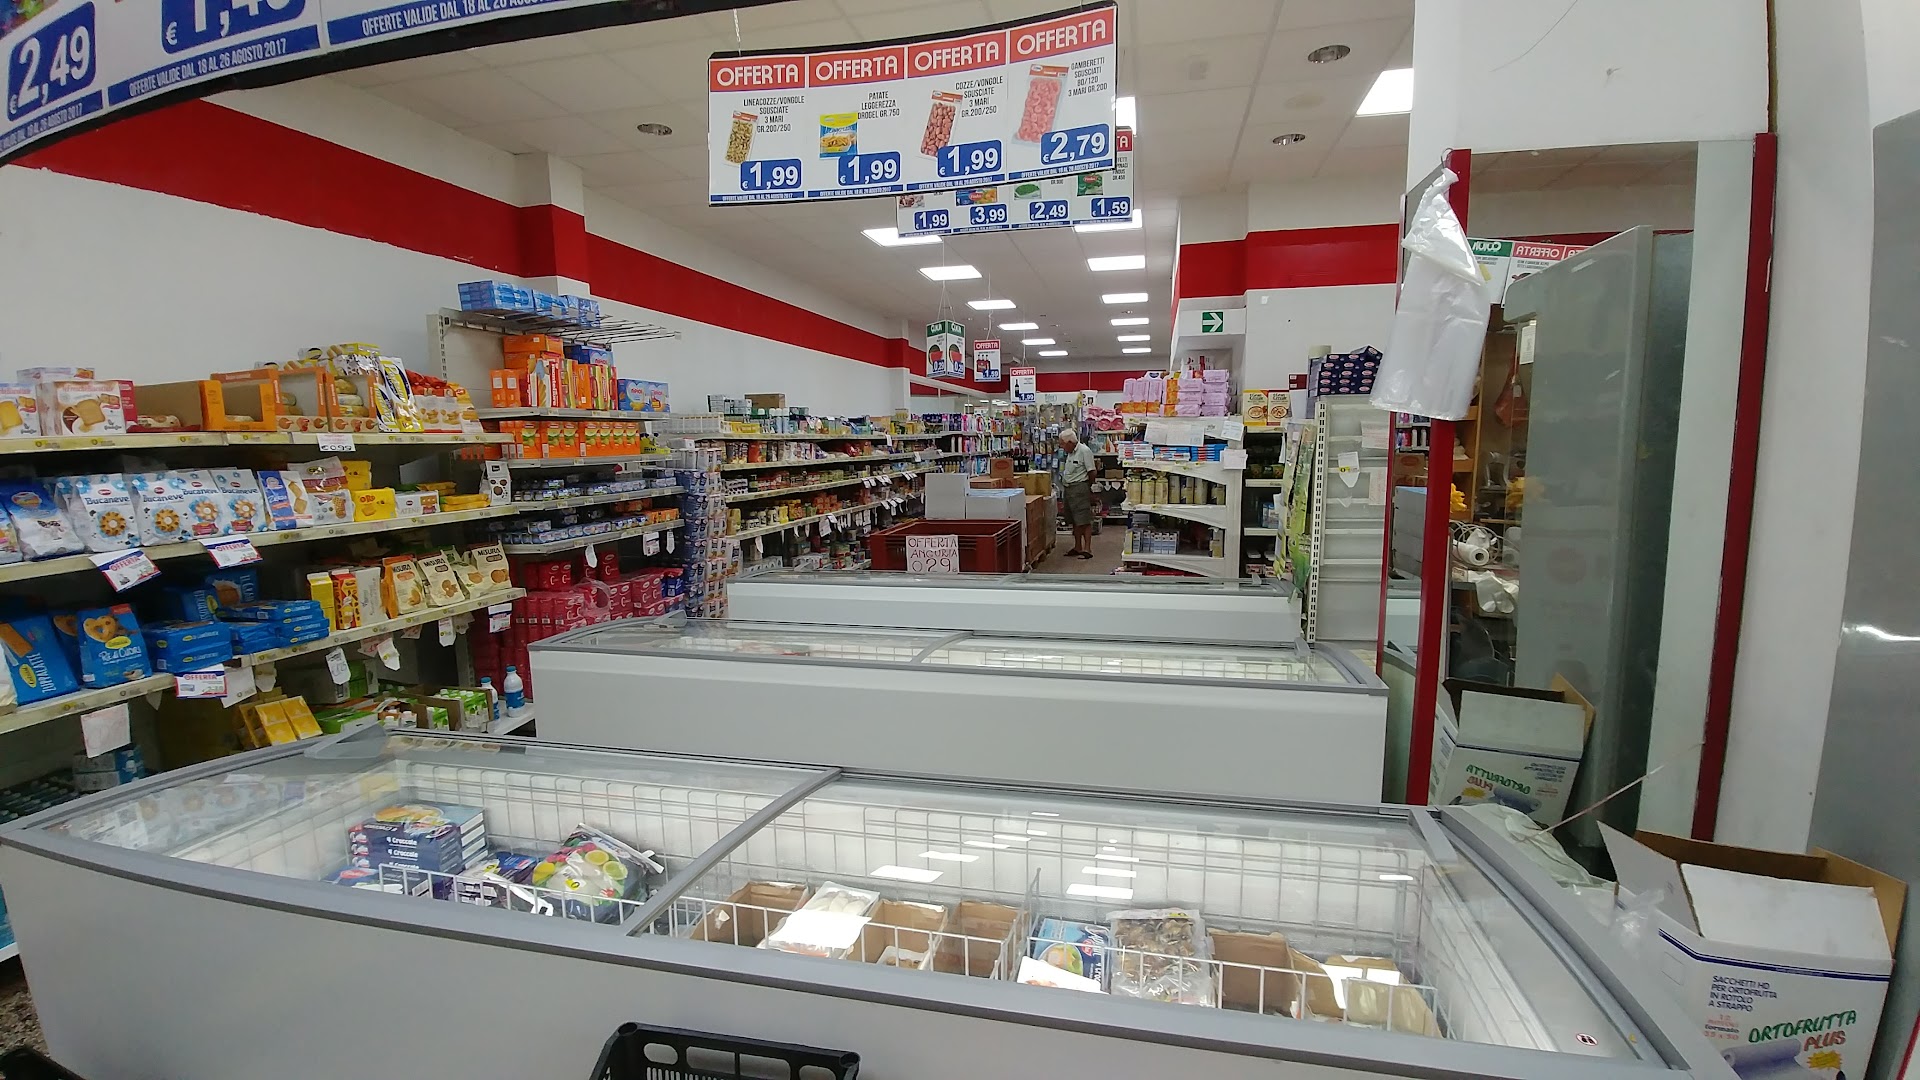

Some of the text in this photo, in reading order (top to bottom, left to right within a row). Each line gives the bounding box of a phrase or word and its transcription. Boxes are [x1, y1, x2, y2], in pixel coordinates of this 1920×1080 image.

[362, 16, 404, 36] OFFERTE
[403, 6, 439, 27] VALIDE
[440, 1, 460, 20] DAL
[462, 0, 475, 15] 18
[1016, 18, 1106, 55] OFFERTA
[914, 41, 999, 71] OFFERTA
[18, 26, 90, 108] 2,49
[129, 37, 287, 97] OFFERTE VALIDE DAL 18 AL 26 AGOSTO 2017
[815, 55, 898, 81] OFFERTA
[1070, 57, 1105, 70] GAMBERETTI
[716, 63, 799, 87] OFFERTA
[1074, 66, 1102, 78] SGUSCIATI
[955, 75, 1004, 90] COZZE/VONGOLE
[868, 91, 889, 100] PATATE
[963, 87, 995, 99] SGUSCIATE
[1068, 89, 1072, 97] 3
[1072, 86, 1087, 96] MARI
[861, 100, 896, 111] LEGGEREZZA
[969, 97, 990, 107] 3 MARI
[68, 103, 83, 119] 2017
[759, 106, 789, 115] SGUSCIATE
[764, 115, 784, 124] 3 MARI
[1050, 132, 1105, 161] 2,79
[947, 146, 999, 175] 1,99
[750, 162, 799, 190] 1,99
[848, 155, 898, 185] 1,99
[974, 206, 1006, 223] 3,99
[1033, 202, 1067, 219] 2,49
[1097, 200, 1128, 217] 1,59
[919, 212, 948, 228] 1,99
[975, 342, 998, 350] OFFERTA
[84, 495, 130, 505] Bucaneve
[143, 494, 184, 503] Bucaneve
[359, 494, 376, 502] ORO
[216, 543, 246, 551] OFFERTA
[908, 537, 957, 548] OFFERTA
[477, 547, 501, 556] MISURA
[109, 556, 141, 571] OFFERTA
[392, 563, 412, 573] MISURA
[423, 557, 446, 567] MISURA
[184, 672, 218, 681] OFFERTA
[1712, 975, 1756, 988] SACCHETTI
[1710, 991, 1753, 1004] IN ROTOLO
[1711, 984, 1778, 999] PER ORTOFRUTTA
[1708, 999, 1753, 1013] A STRAPPO
[1748, 1010, 1857, 1043] ORTOFRUTTA
[1803, 1030, 1846, 1052] PLUS
